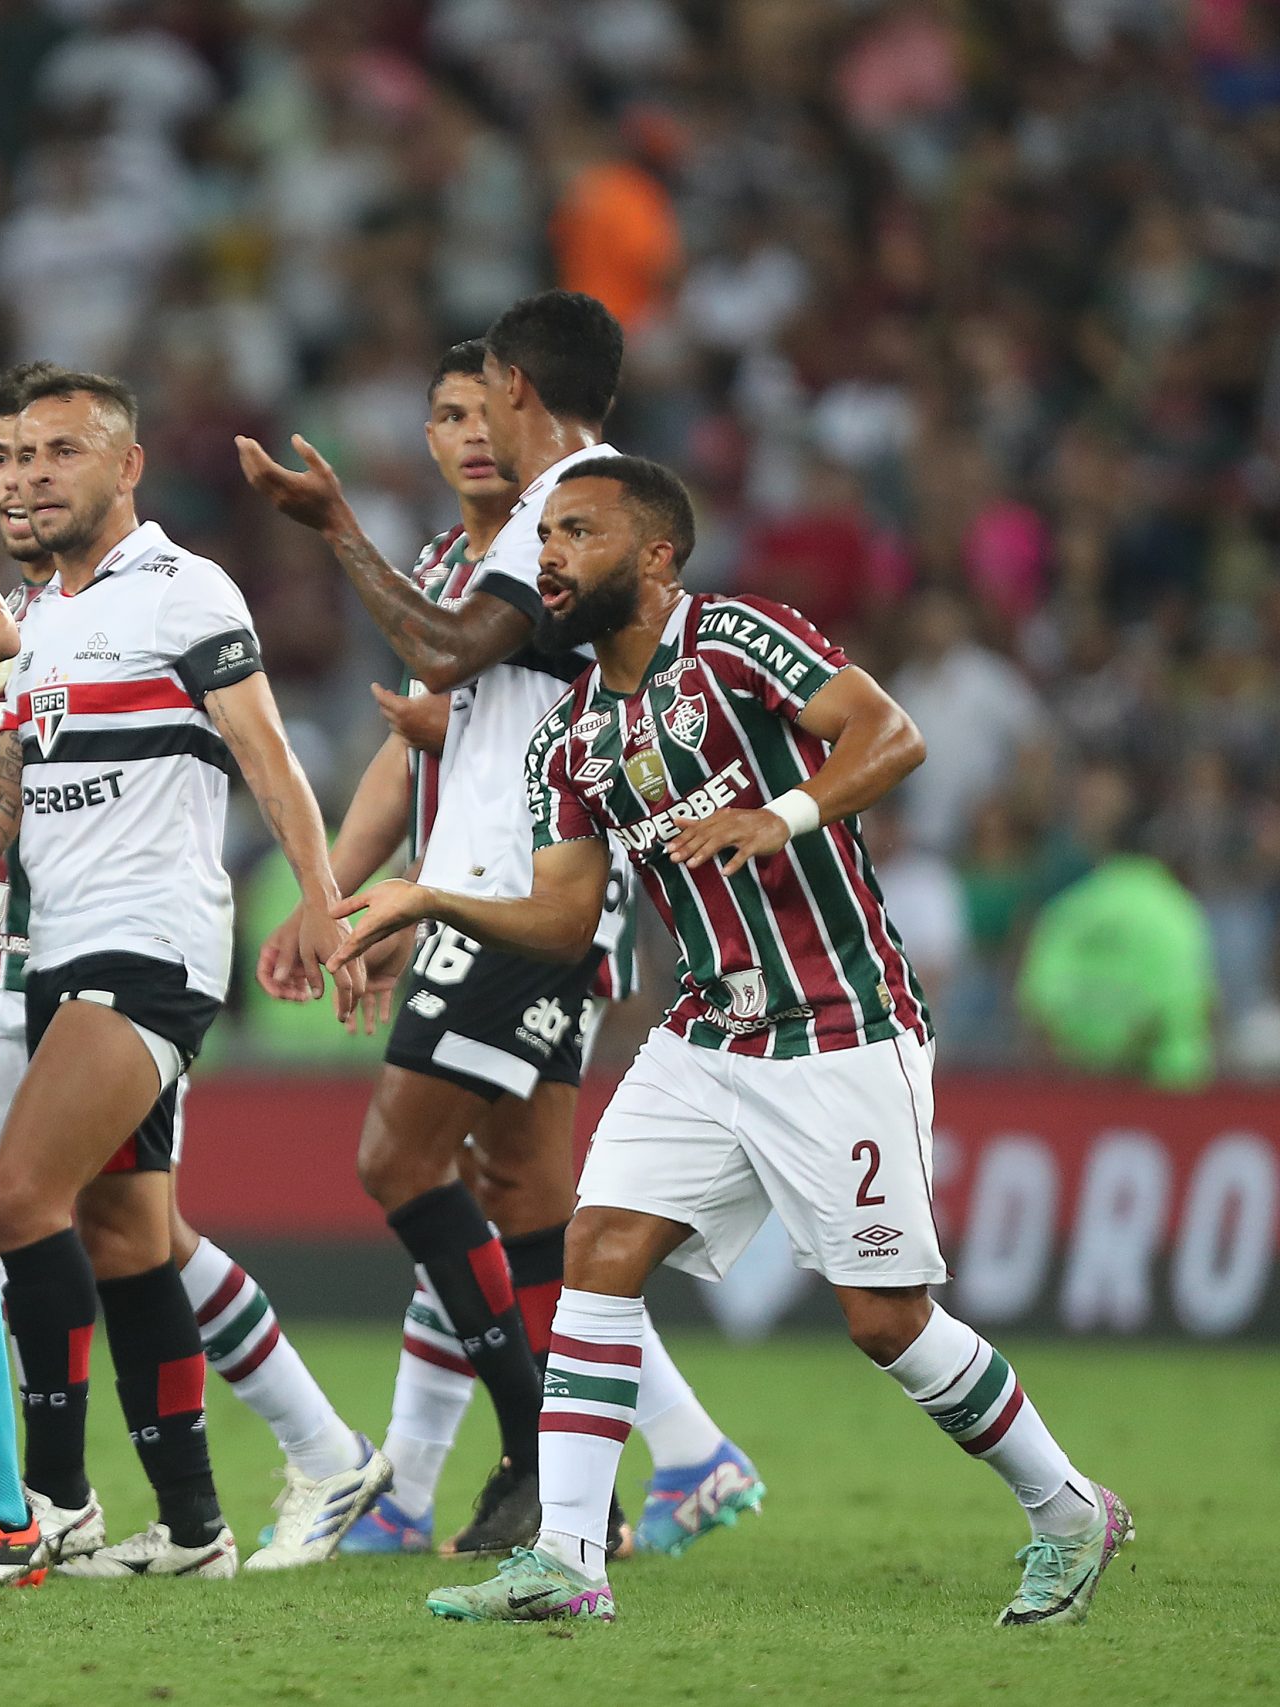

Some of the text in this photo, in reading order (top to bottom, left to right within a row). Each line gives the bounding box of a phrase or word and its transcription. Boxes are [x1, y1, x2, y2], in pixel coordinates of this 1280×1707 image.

[73, 650, 121, 662] ADEMICON
[228, 657, 254, 669] balance
[698, 612, 809, 687] ZINZANE
[34, 692, 64, 713] SPFC
[571, 713, 611, 735] RESCATTO
[21, 769, 124, 815] PERBET
[584, 779, 614, 798] umbro
[610, 758, 752, 852] SUPERBET
[412, 918, 483, 986] 16
[851, 1139, 886, 1208] 2
[933, 1128, 1280, 1338] DRO
[858, 1247, 899, 1258] umbro
